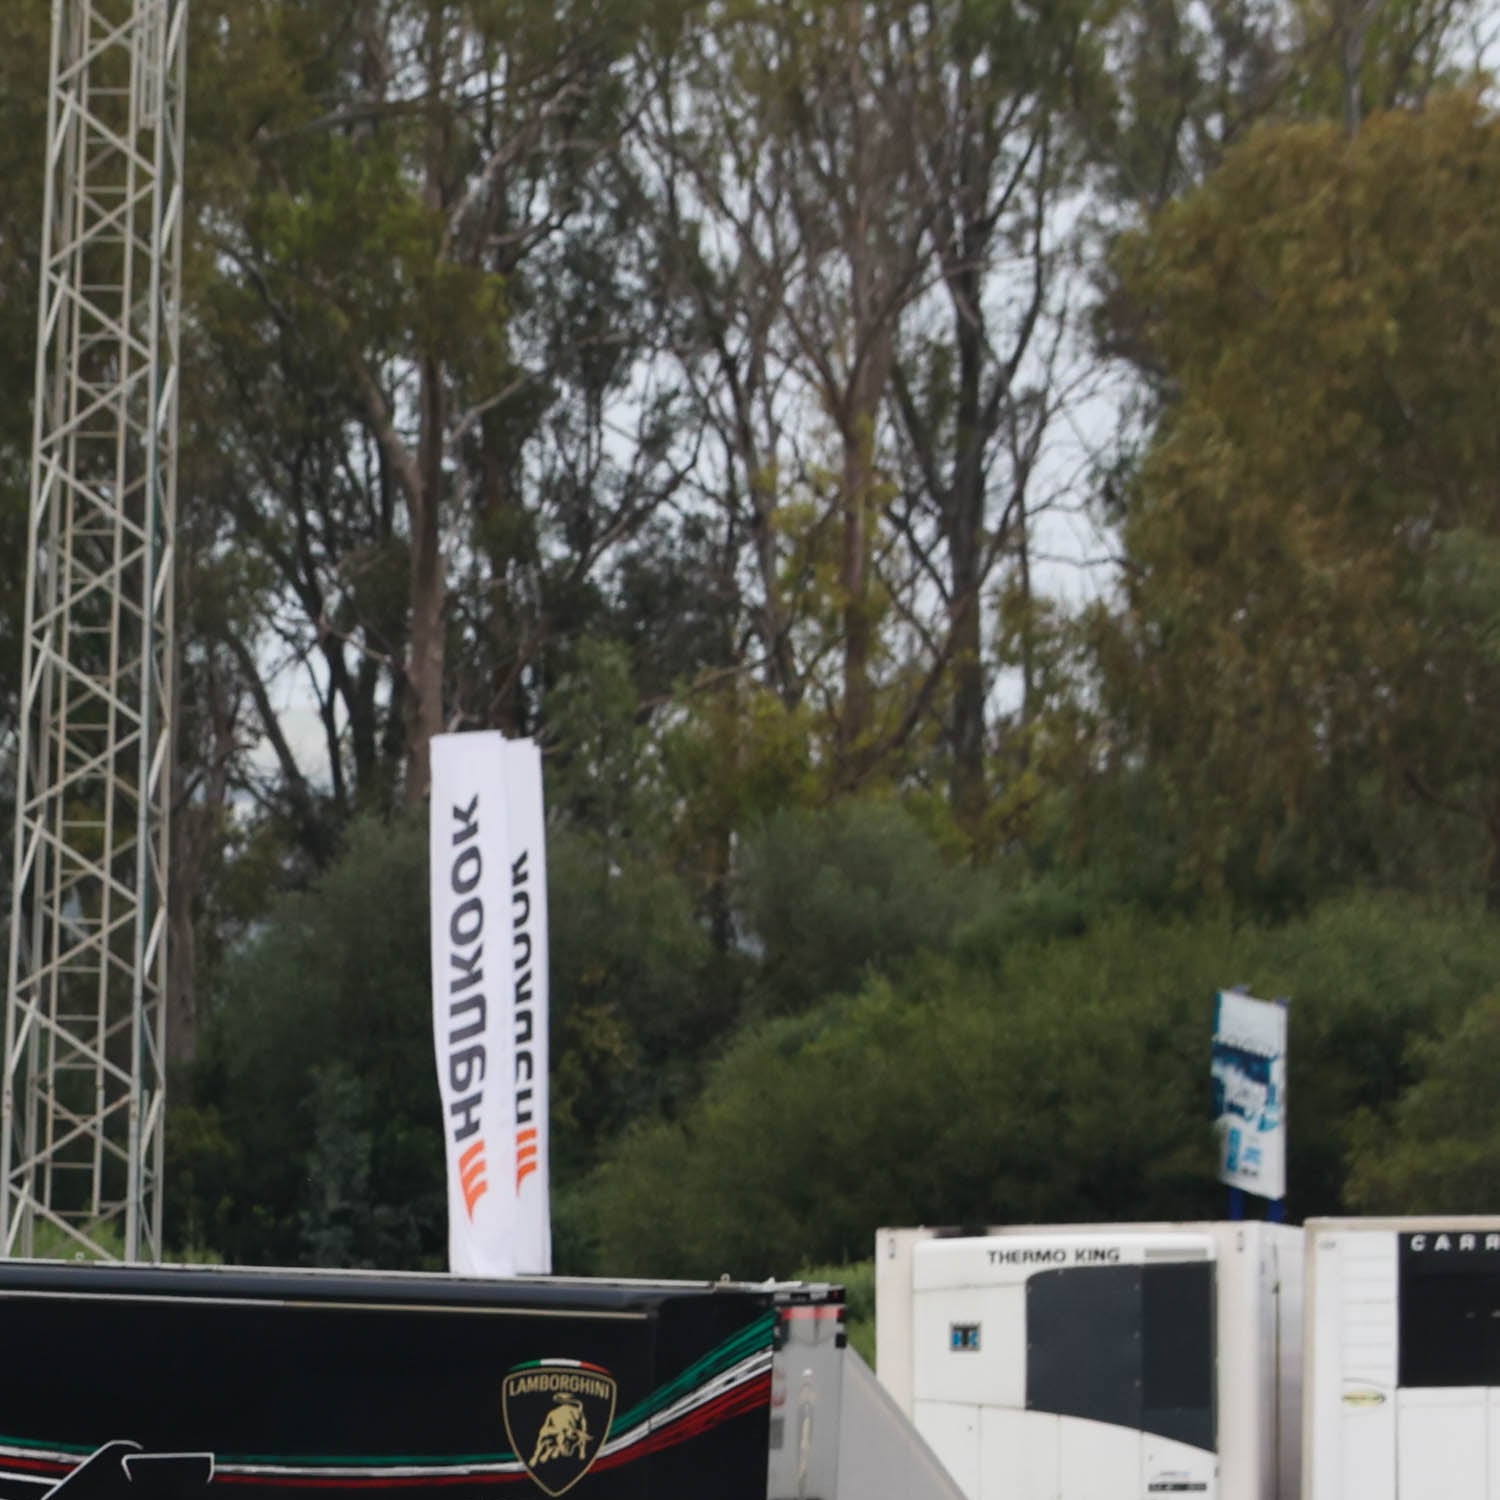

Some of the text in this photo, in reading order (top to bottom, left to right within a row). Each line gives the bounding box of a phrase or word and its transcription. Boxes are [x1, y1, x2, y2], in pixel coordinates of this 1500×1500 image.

[989, 1247, 1121, 1265] THERMO KING
[508, 1374, 610, 1400] LAMBORGHINI
